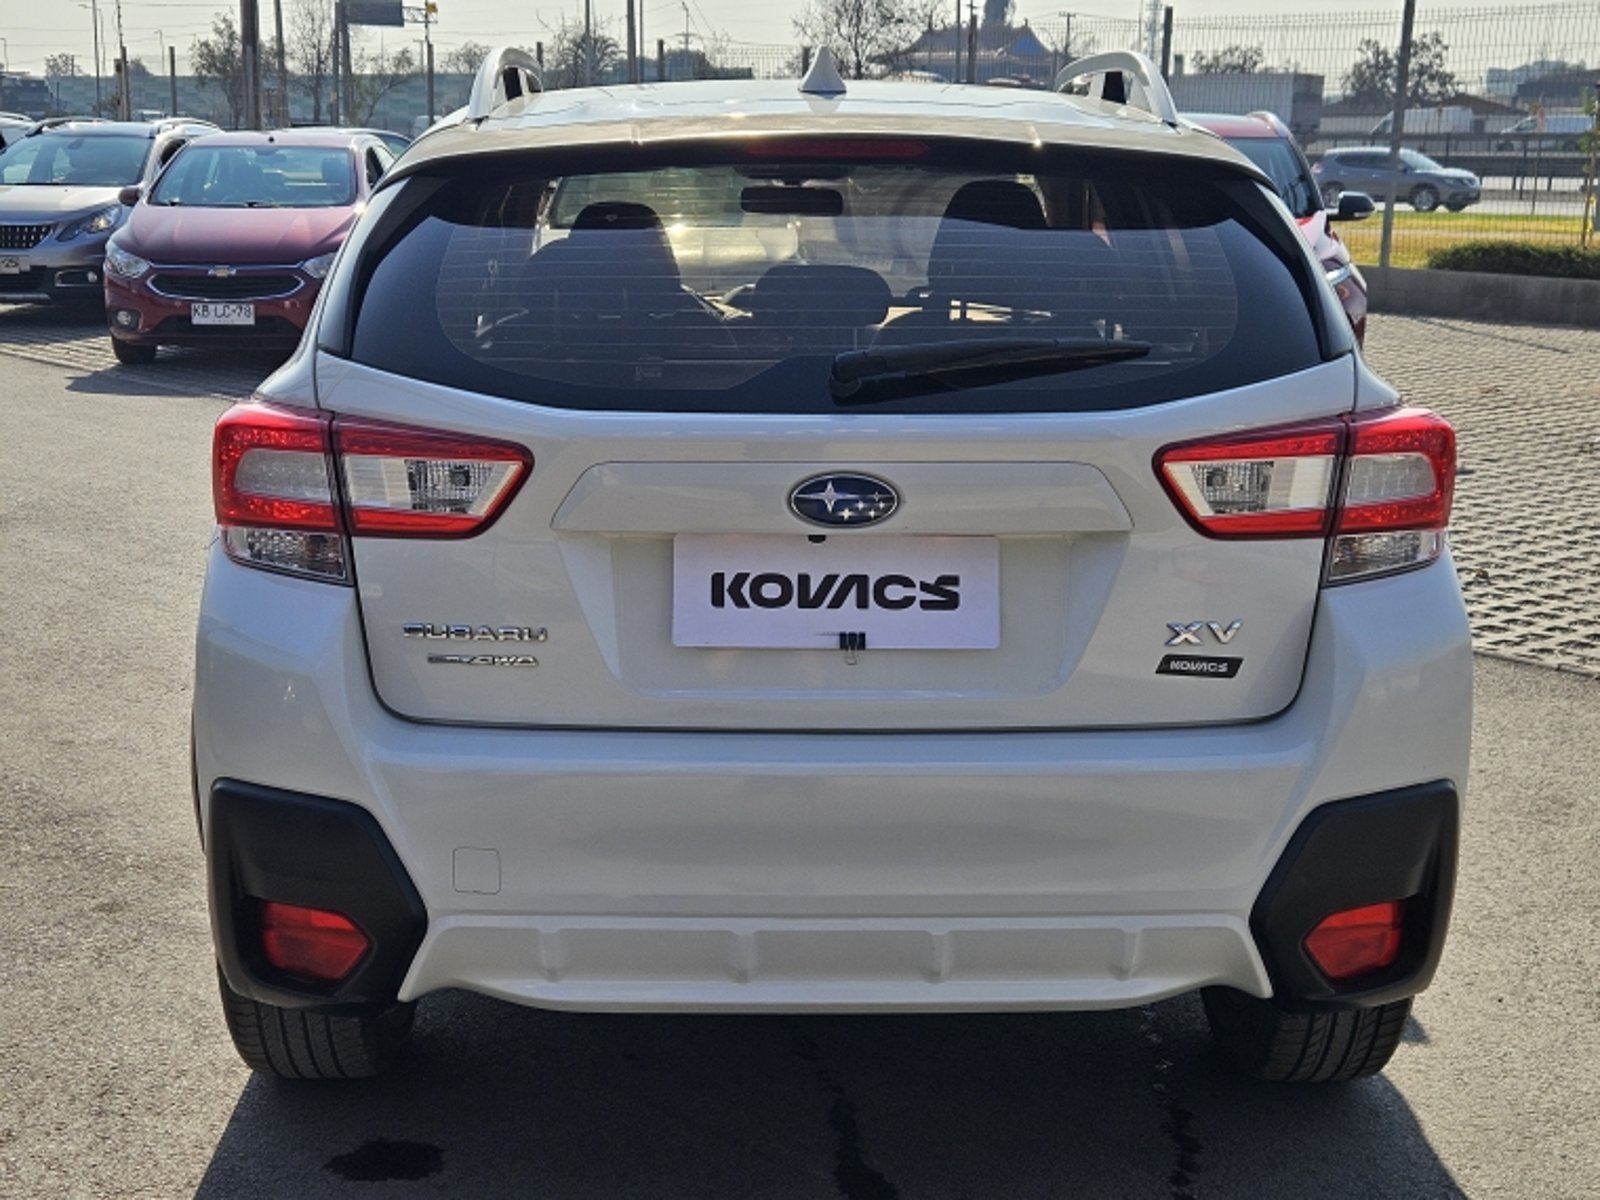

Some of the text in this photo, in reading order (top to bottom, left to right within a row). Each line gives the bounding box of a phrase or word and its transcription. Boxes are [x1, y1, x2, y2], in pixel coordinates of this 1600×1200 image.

[193, 304, 210, 318] KB
[711, 572, 960, 611] KOVACS
[402, 622, 549, 643] SUBARU
[1164, 618, 1243, 646] XV
[1169, 660, 1229, 673] KOVACS
